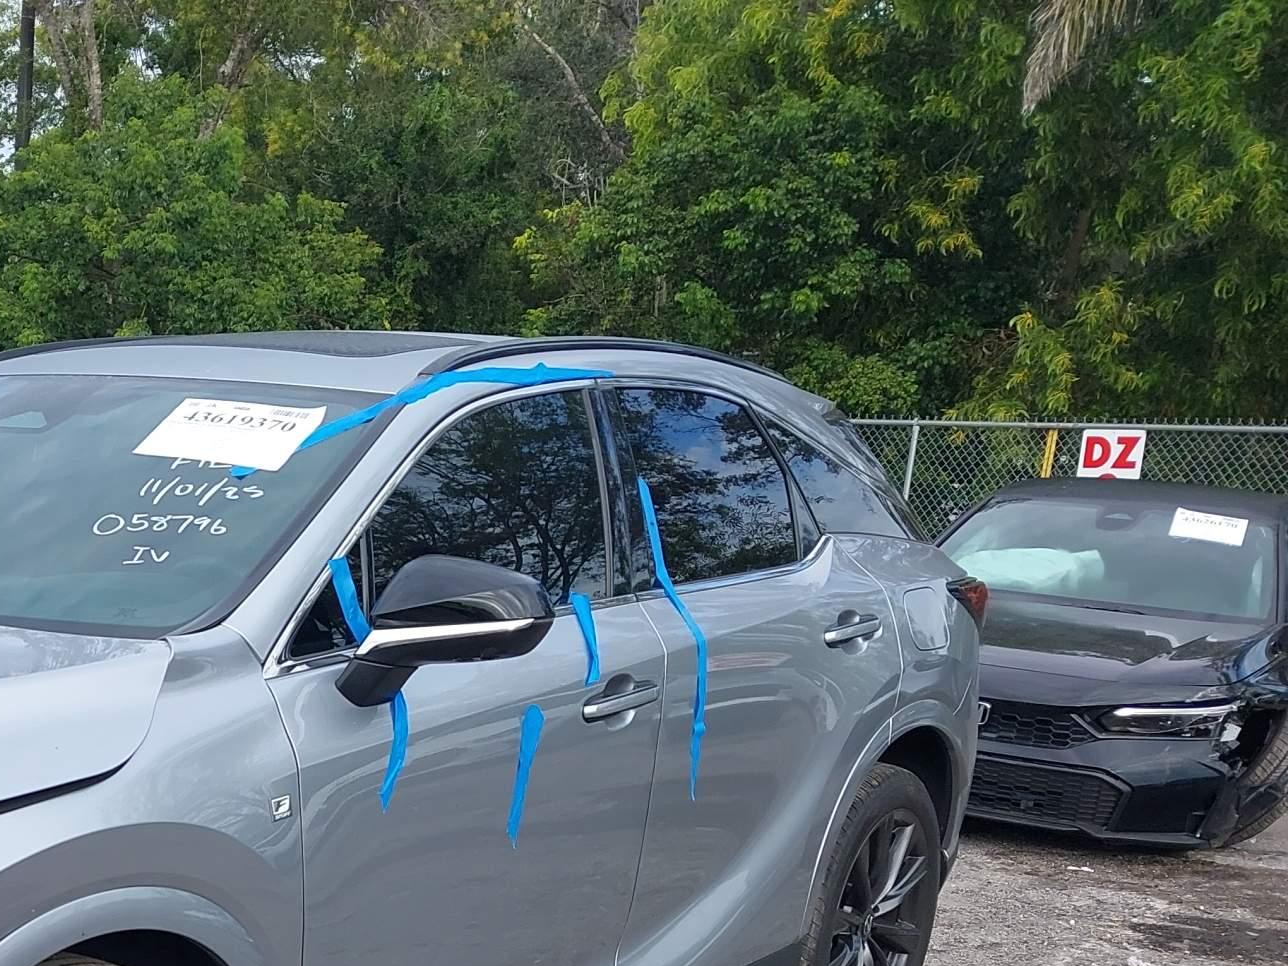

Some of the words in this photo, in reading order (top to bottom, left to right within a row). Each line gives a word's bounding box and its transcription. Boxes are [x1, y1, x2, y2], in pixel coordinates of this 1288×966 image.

[184, 410, 297, 433] 43619370
[1082, 436, 1142, 469] DZ
[139, 477, 264, 506] 11/01/25
[92, 513, 227, 536] 058796
[122, 546, 170, 565] IV
